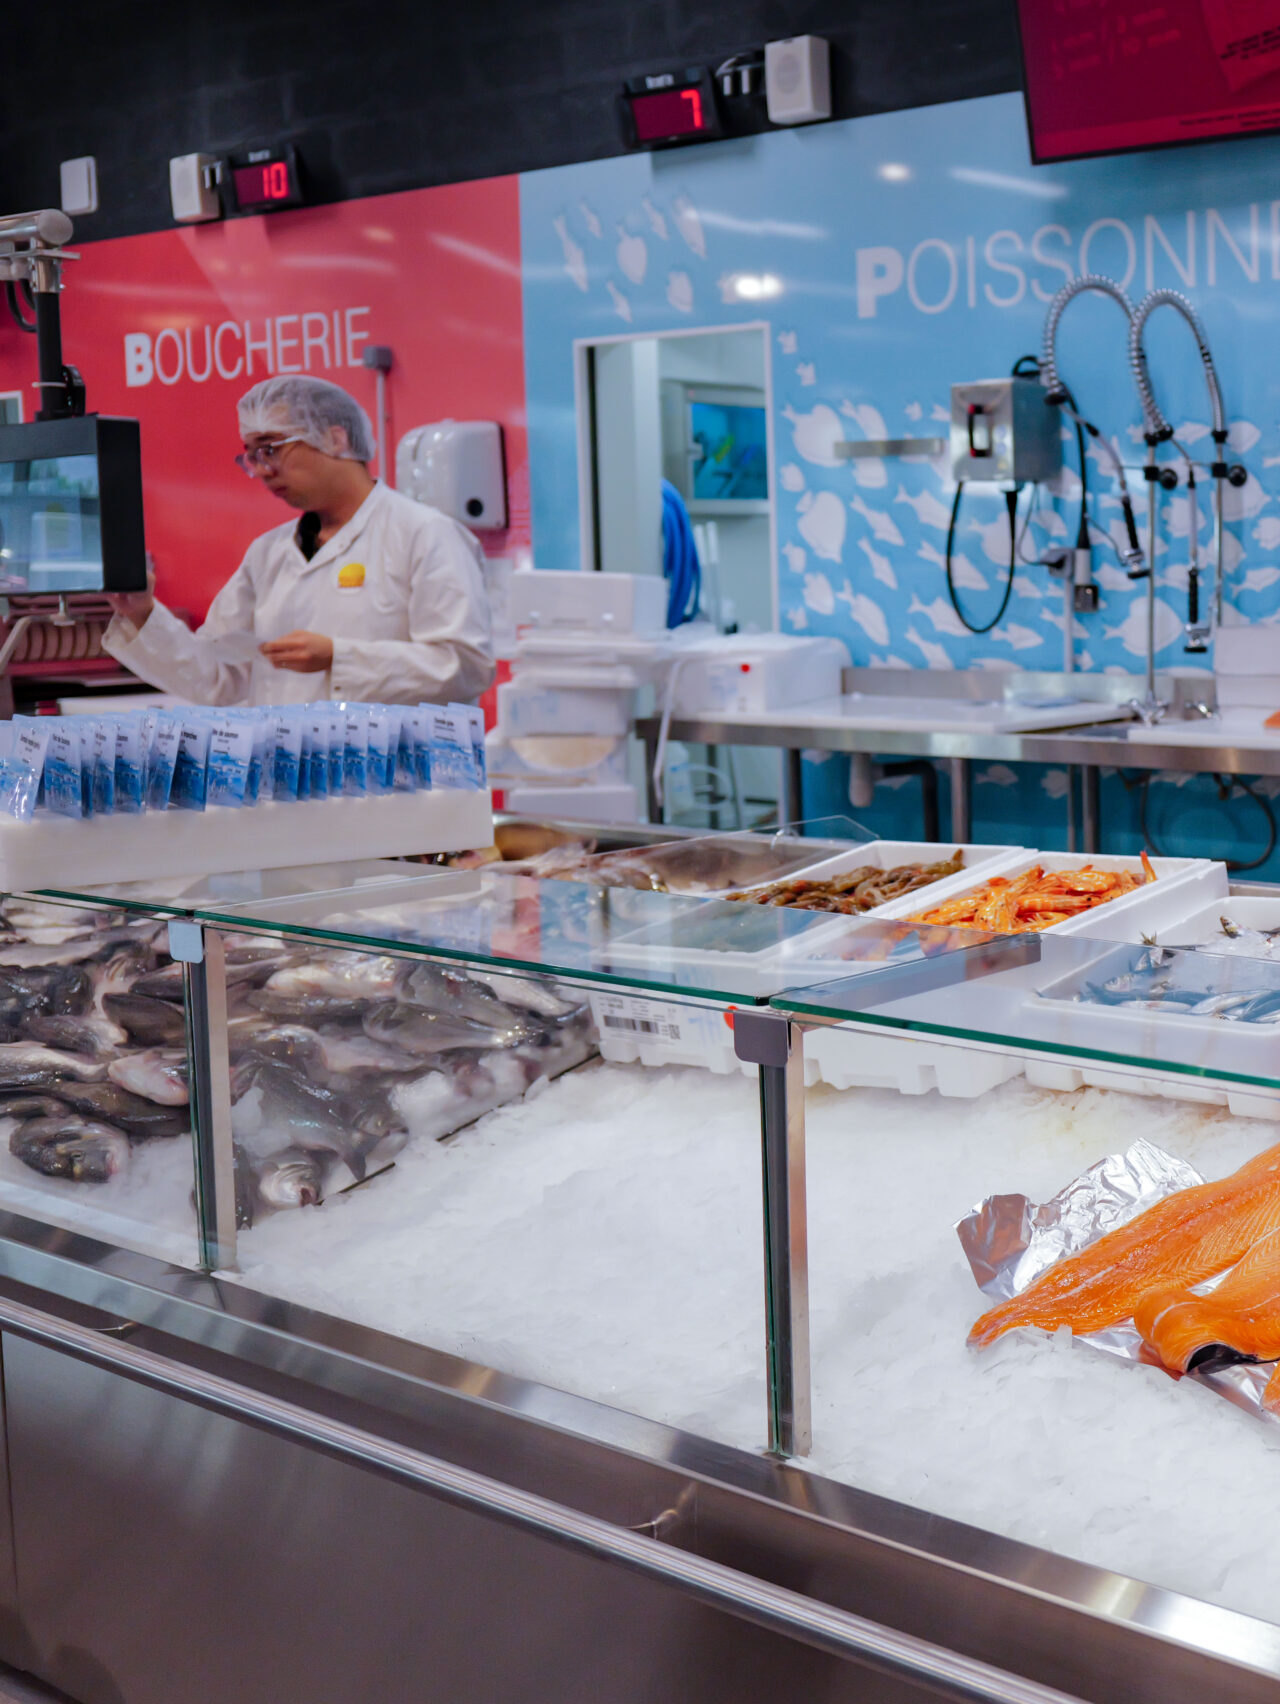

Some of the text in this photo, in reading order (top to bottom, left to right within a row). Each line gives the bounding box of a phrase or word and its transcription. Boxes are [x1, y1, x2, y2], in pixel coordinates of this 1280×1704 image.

[681, 89, 703, 128] 7
[262, 162, 288, 199] 10
[124, 306, 371, 388] BOUCHERIE
